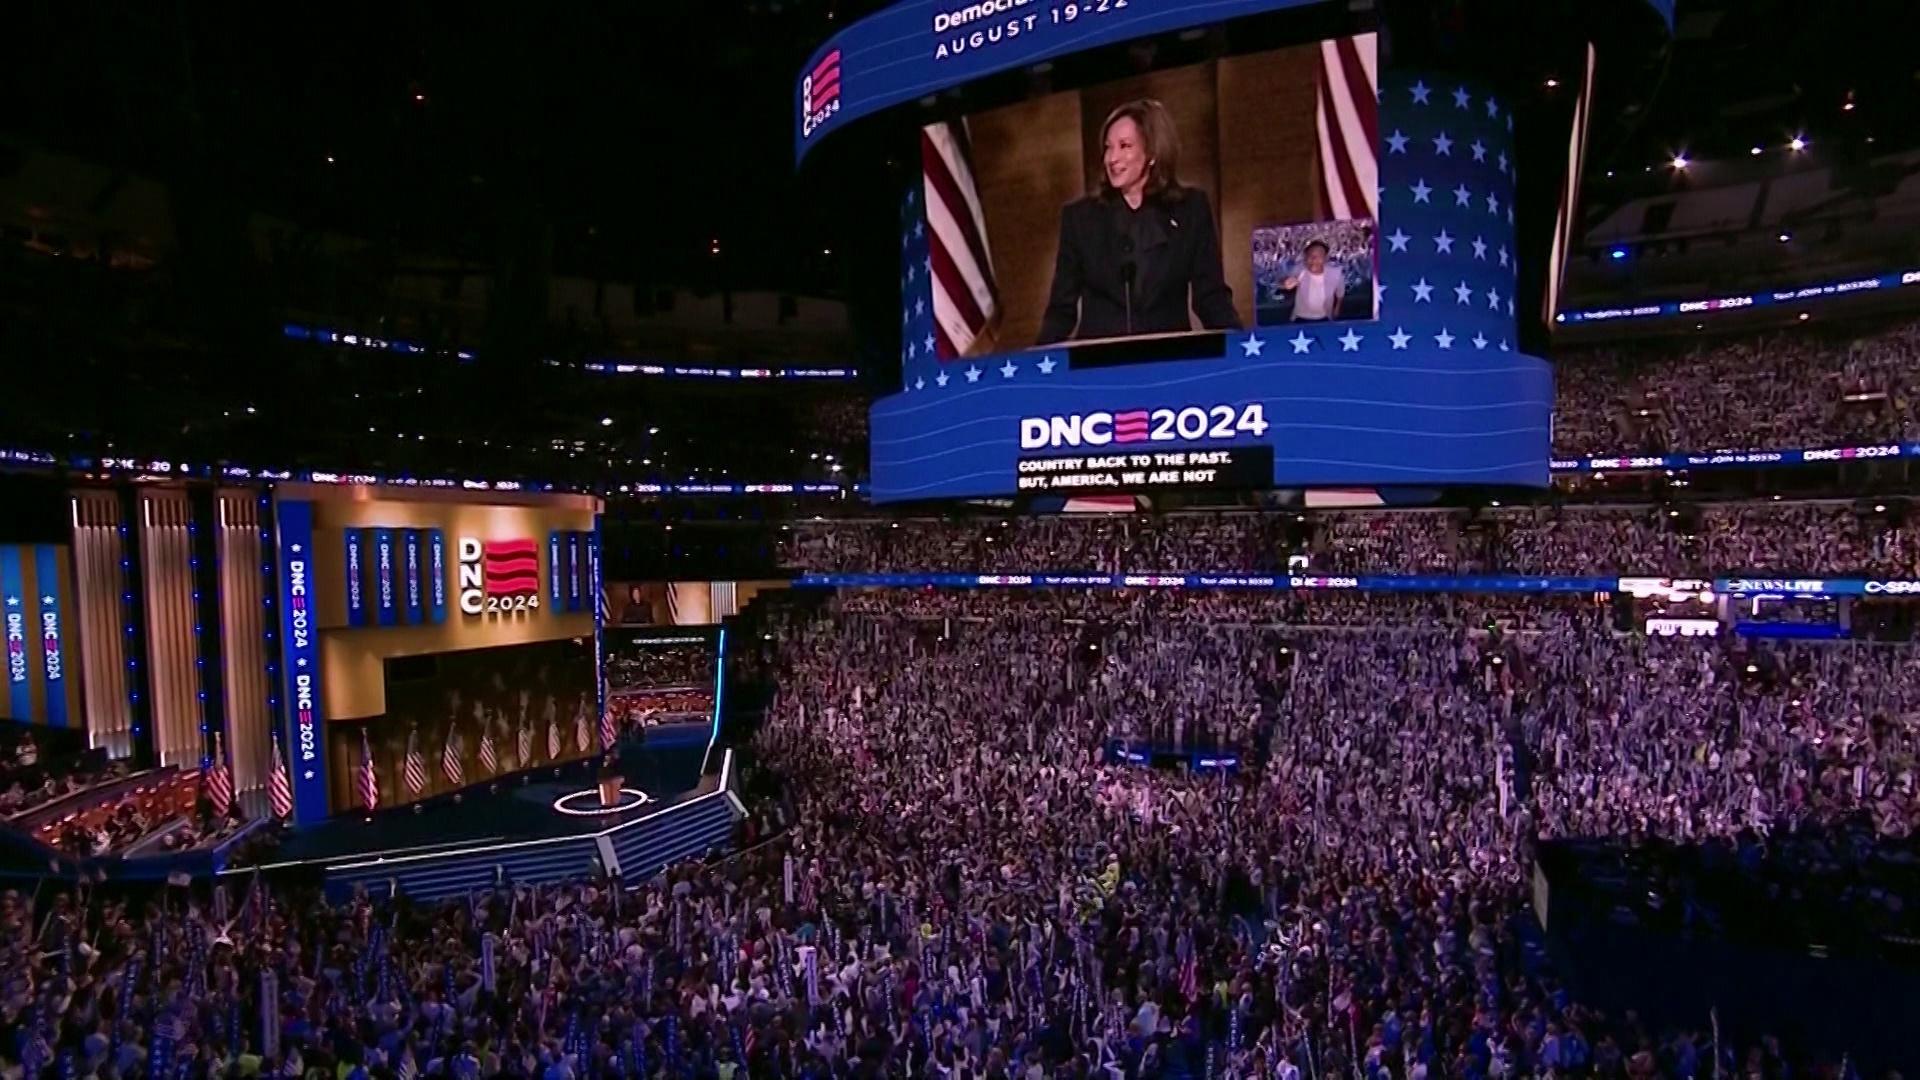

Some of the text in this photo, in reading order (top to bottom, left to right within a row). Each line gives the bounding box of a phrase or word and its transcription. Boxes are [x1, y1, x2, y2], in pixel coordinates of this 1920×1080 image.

[935, 14, 1038, 60] AUGUST
[1020, 403, 1268, 449] DNC 2024
[1019, 451, 1233, 472] COUNTRY BACK TO THE PAST.
[1630, 457, 1663, 467] 2024
[1803, 445, 1900, 461] DNC 2024
[1019, 469, 1217, 489] BUT, AMERICA, WE ARE NOT
[1008, 575, 1032, 585] 2024
[1157, 576, 1185, 586] 2024
[1327, 577, 1358, 587] 2024
[290, 561, 308, 648] DNC 2024
[487, 594, 540, 613] 2024
[8, 613, 26, 681] DNC 2024
[43, 612, 61, 679] DNC 2024
[296, 675, 315, 761] DNC 2024
